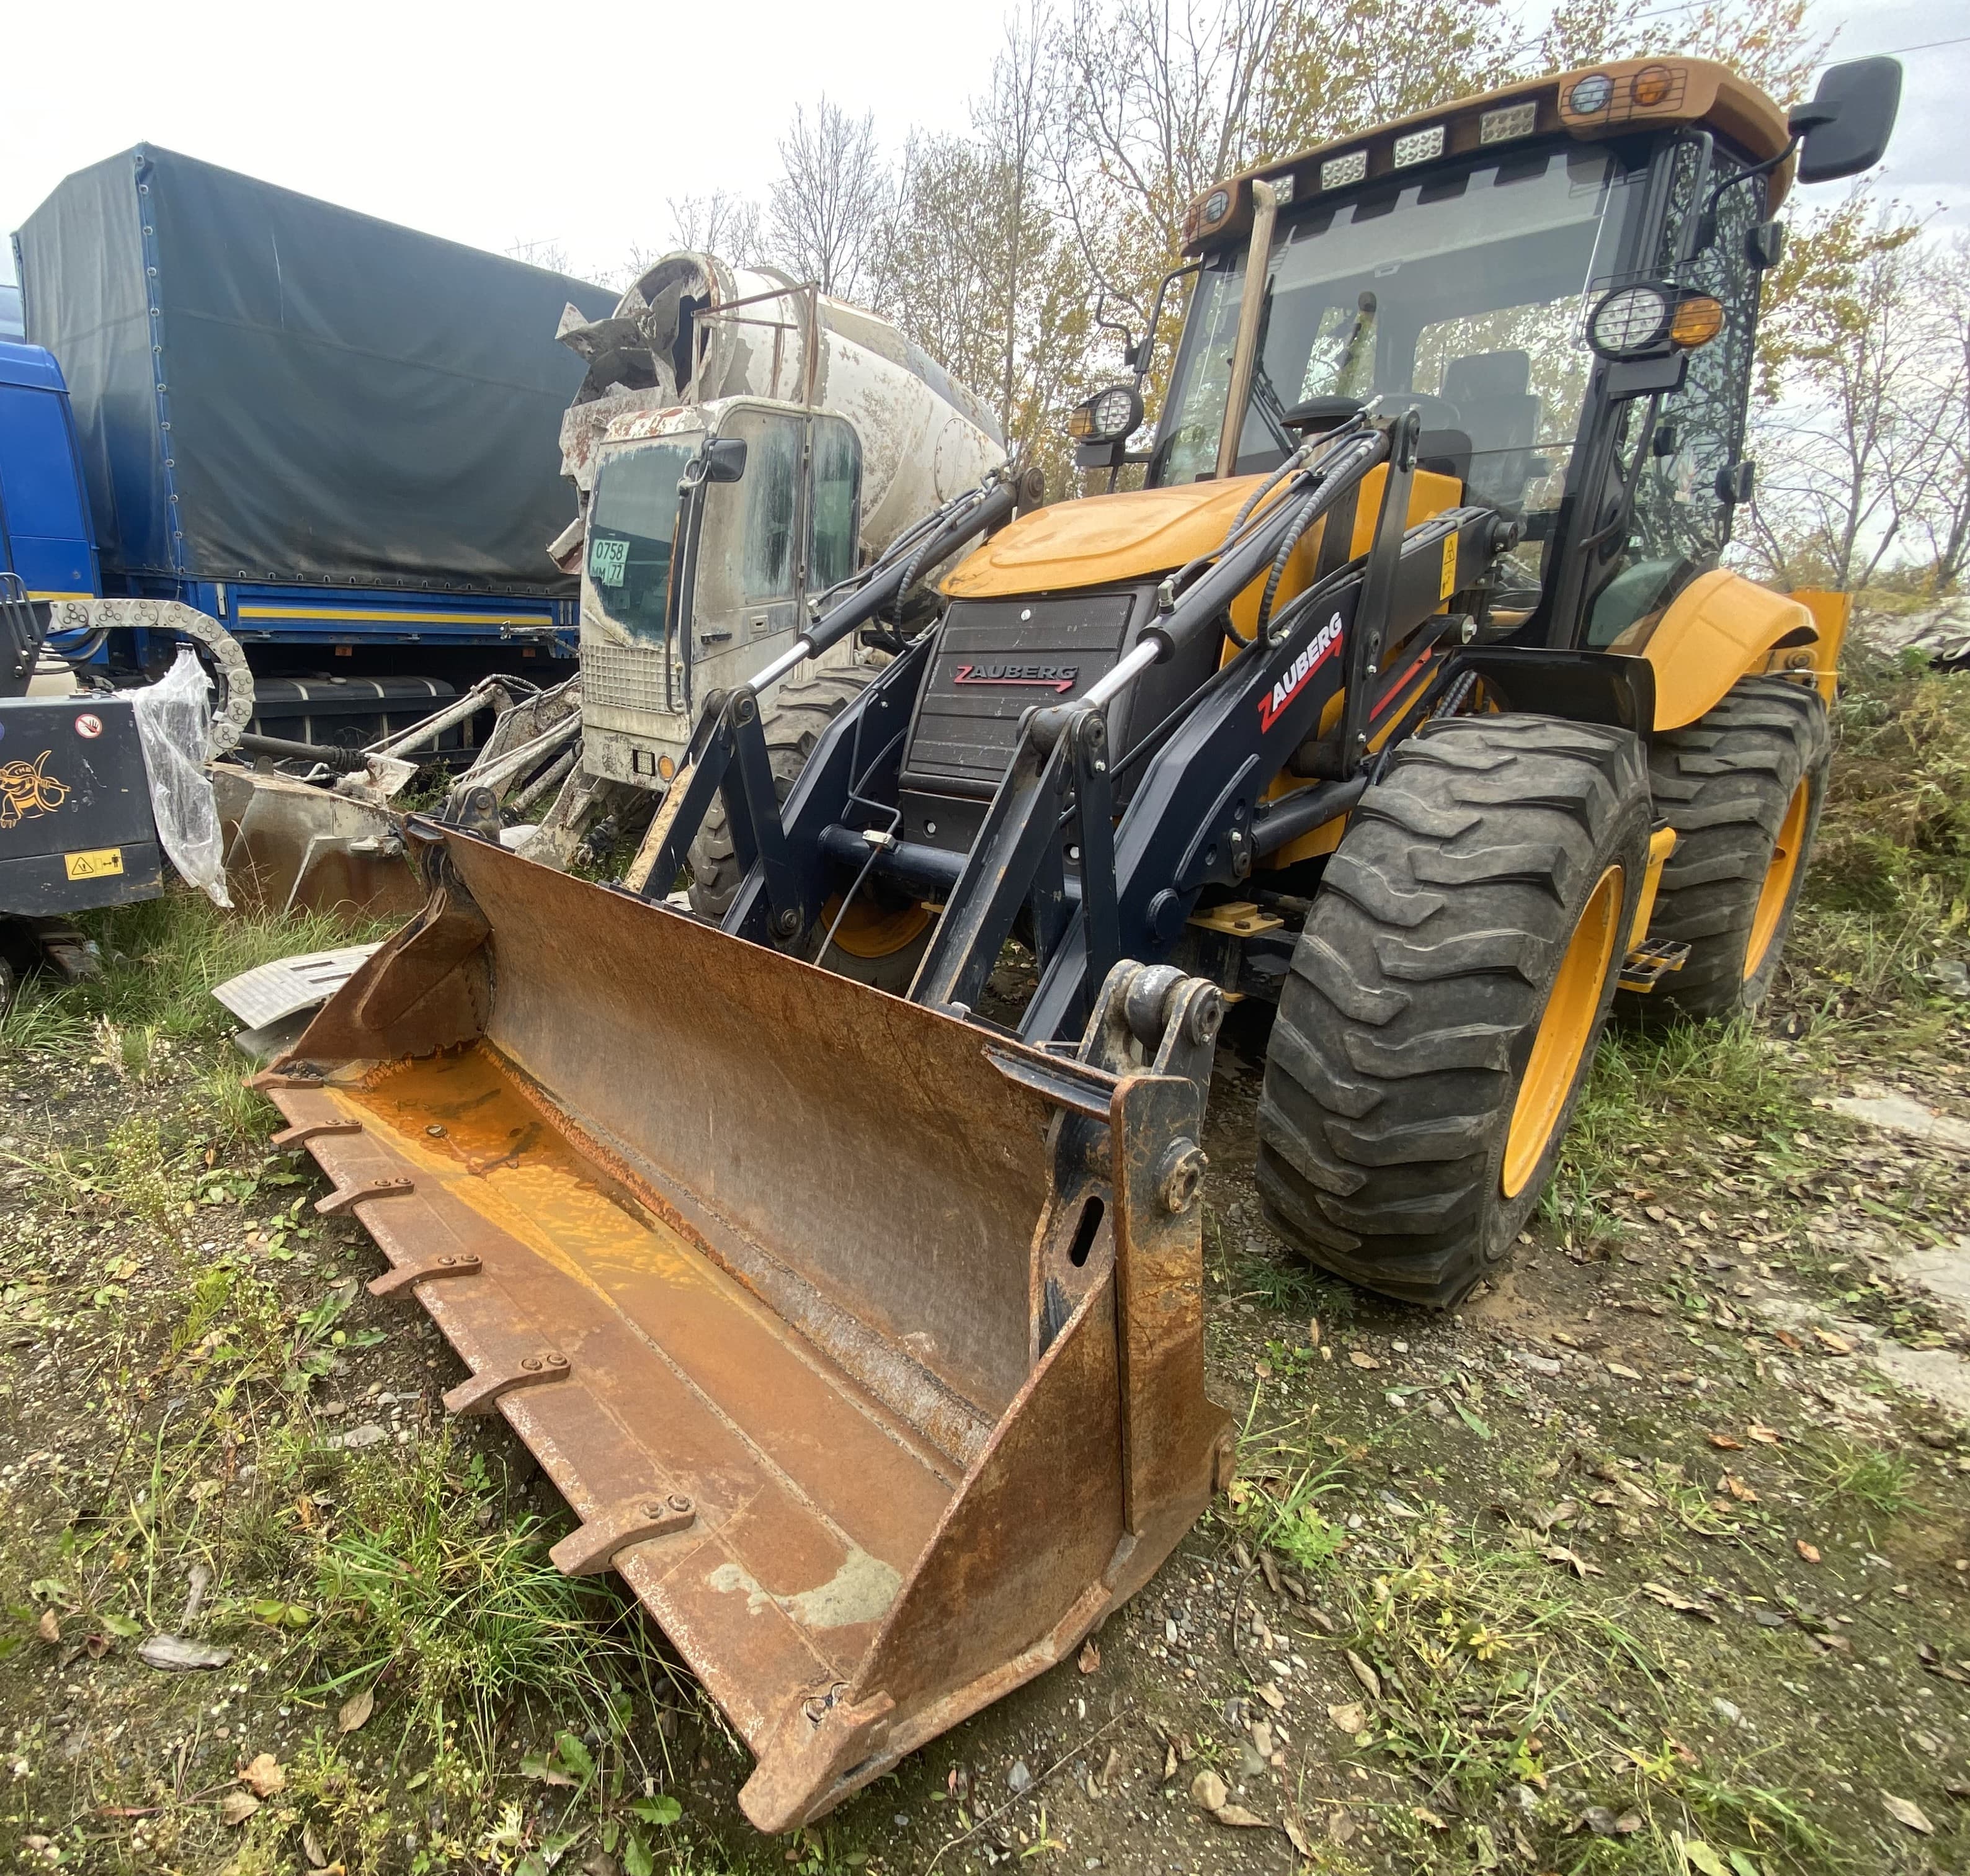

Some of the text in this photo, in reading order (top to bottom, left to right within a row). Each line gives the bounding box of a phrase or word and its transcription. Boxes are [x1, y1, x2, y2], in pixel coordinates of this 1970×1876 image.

[596, 542, 624, 560] 0758
[610, 564, 622, 579] 77
[954, 664, 1079, 690] ZAUBERG
[1257, 611, 1344, 735] ZAUBERG
